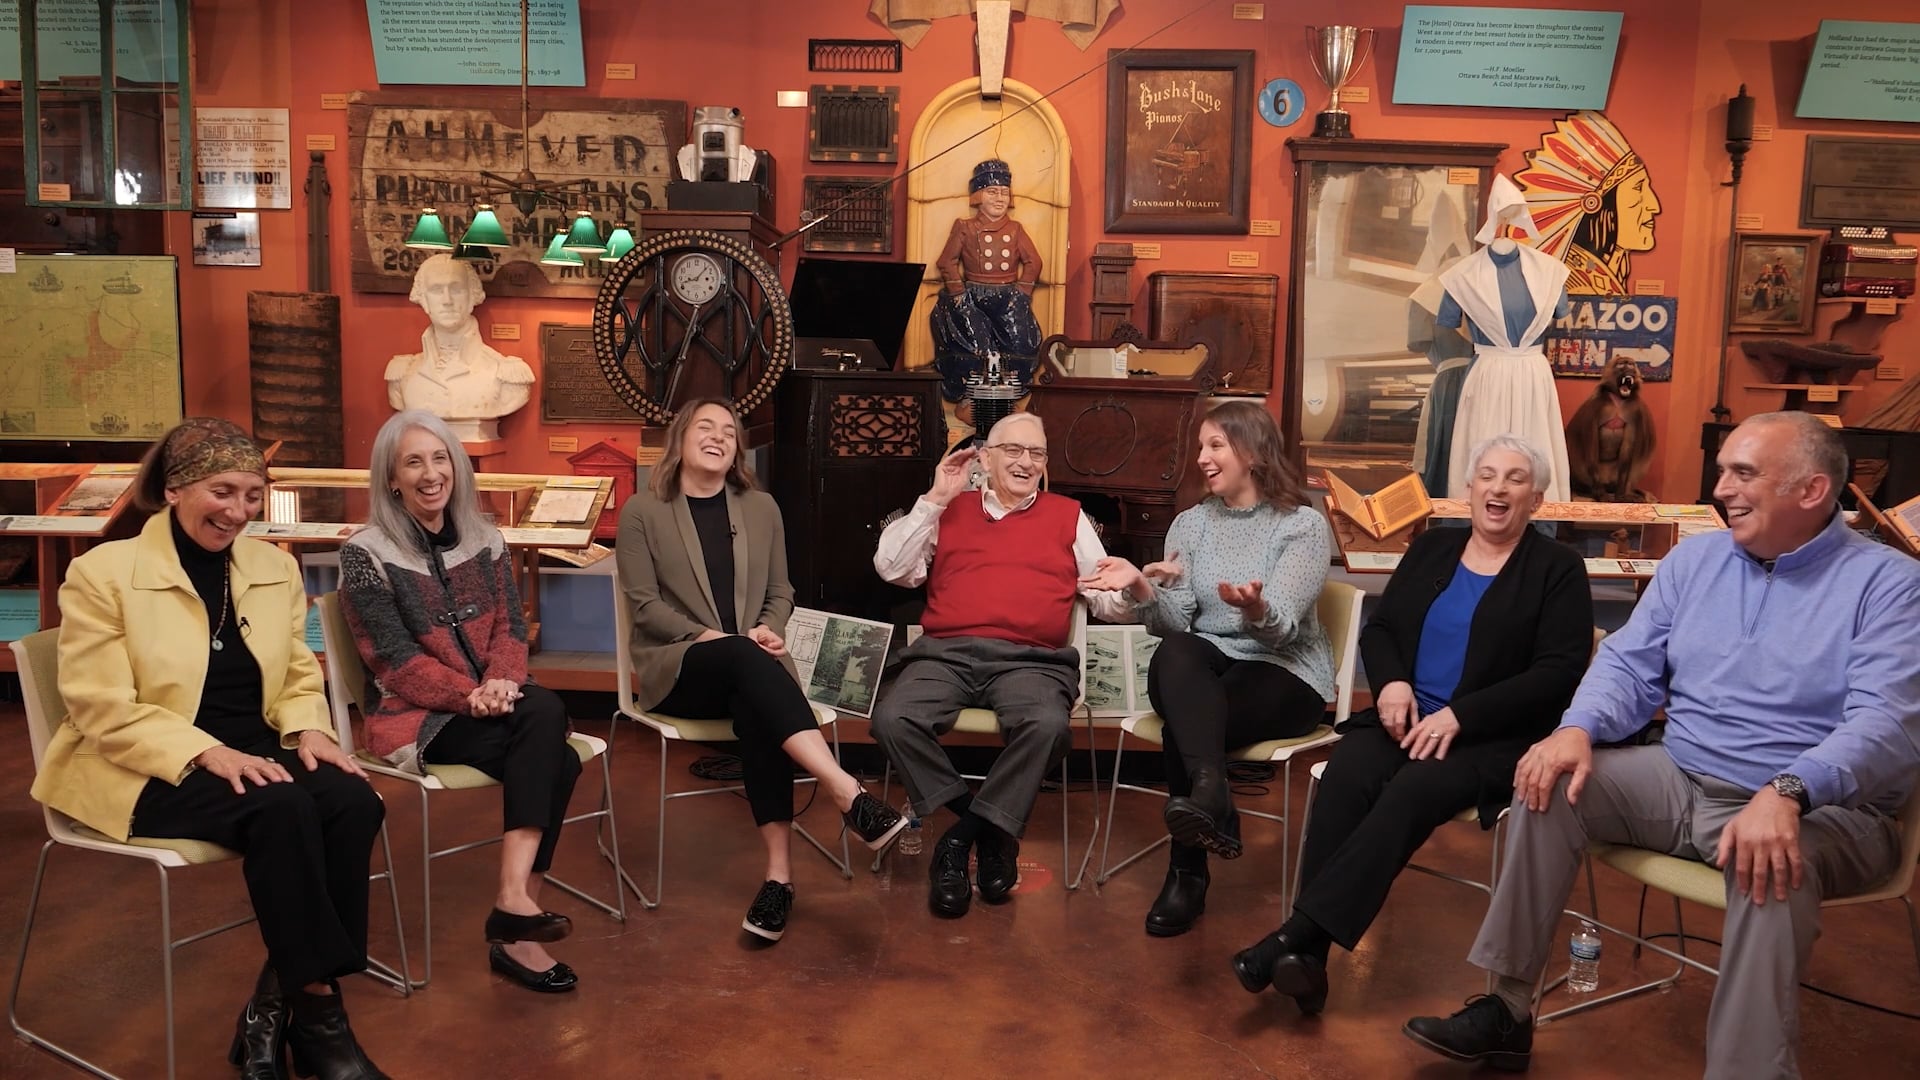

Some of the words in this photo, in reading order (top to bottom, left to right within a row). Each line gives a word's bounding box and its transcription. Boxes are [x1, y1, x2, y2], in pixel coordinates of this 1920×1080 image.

[1273, 89, 1290, 116] 6
[1145, 110, 1183, 131] Pianos
[233, 172, 280, 184] FUND!!
[1132, 199, 1175, 208] STANDARD
[1176, 199, 1184, 208] IN
[1186, 199, 1221, 209] QUALITY
[1556, 301, 1668, 332] KAZOO
